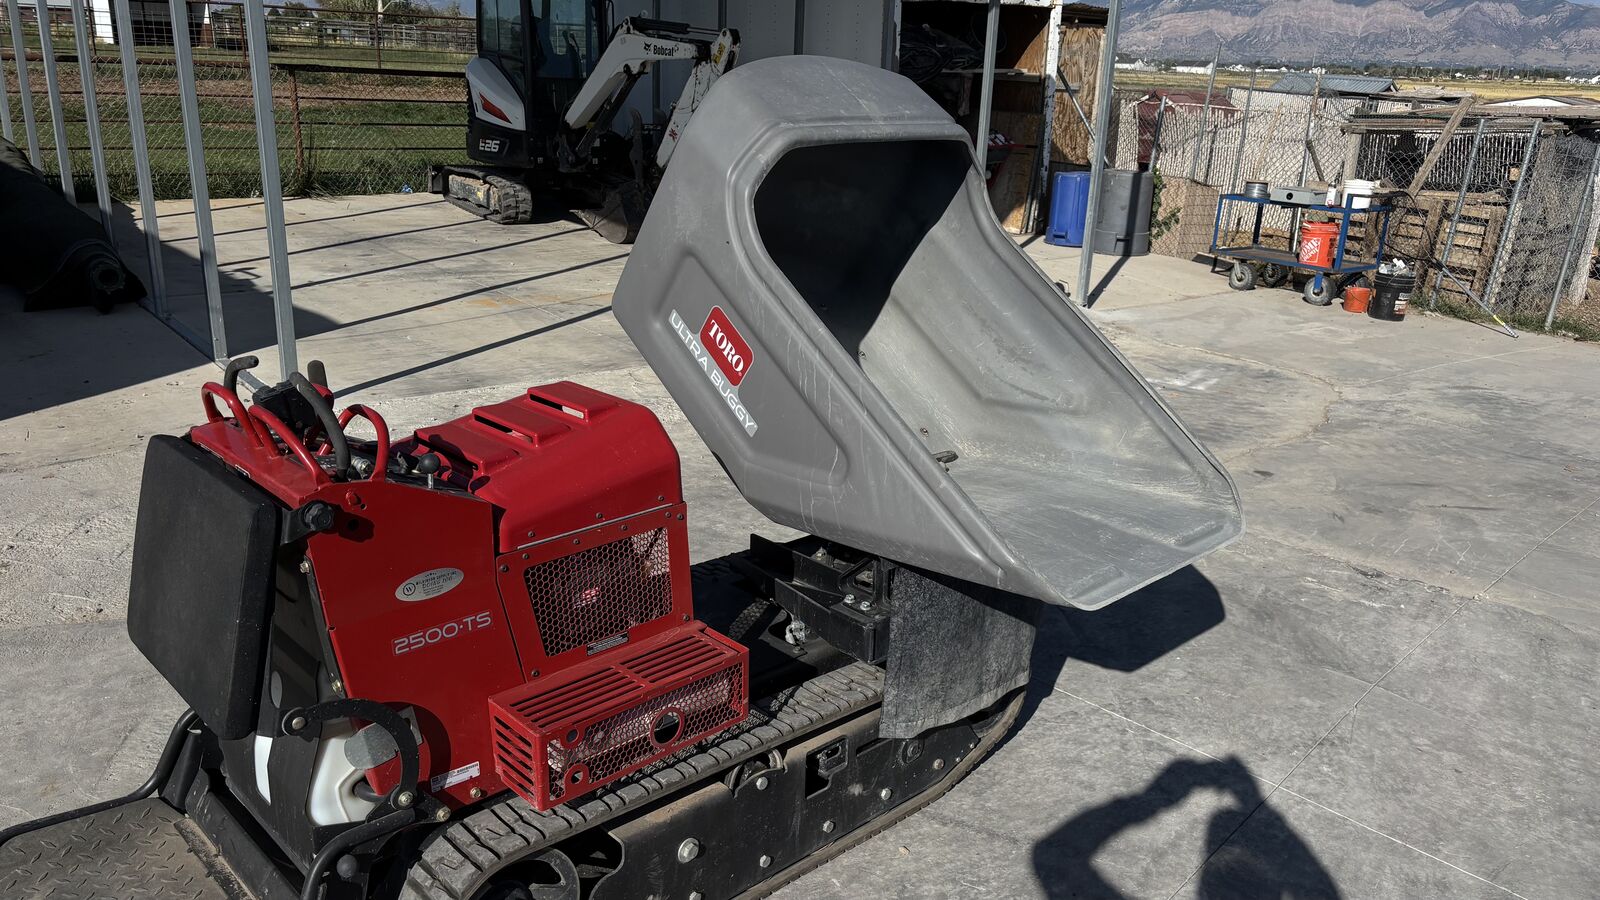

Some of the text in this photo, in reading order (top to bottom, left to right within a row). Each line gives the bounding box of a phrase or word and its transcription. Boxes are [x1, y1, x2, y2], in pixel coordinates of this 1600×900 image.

[653, 44, 674, 57] Bobcat
[479, 138, 500, 152] E26
[708, 319, 744, 372] TORO
[671, 312, 756, 428] ULTRA BUGGY
